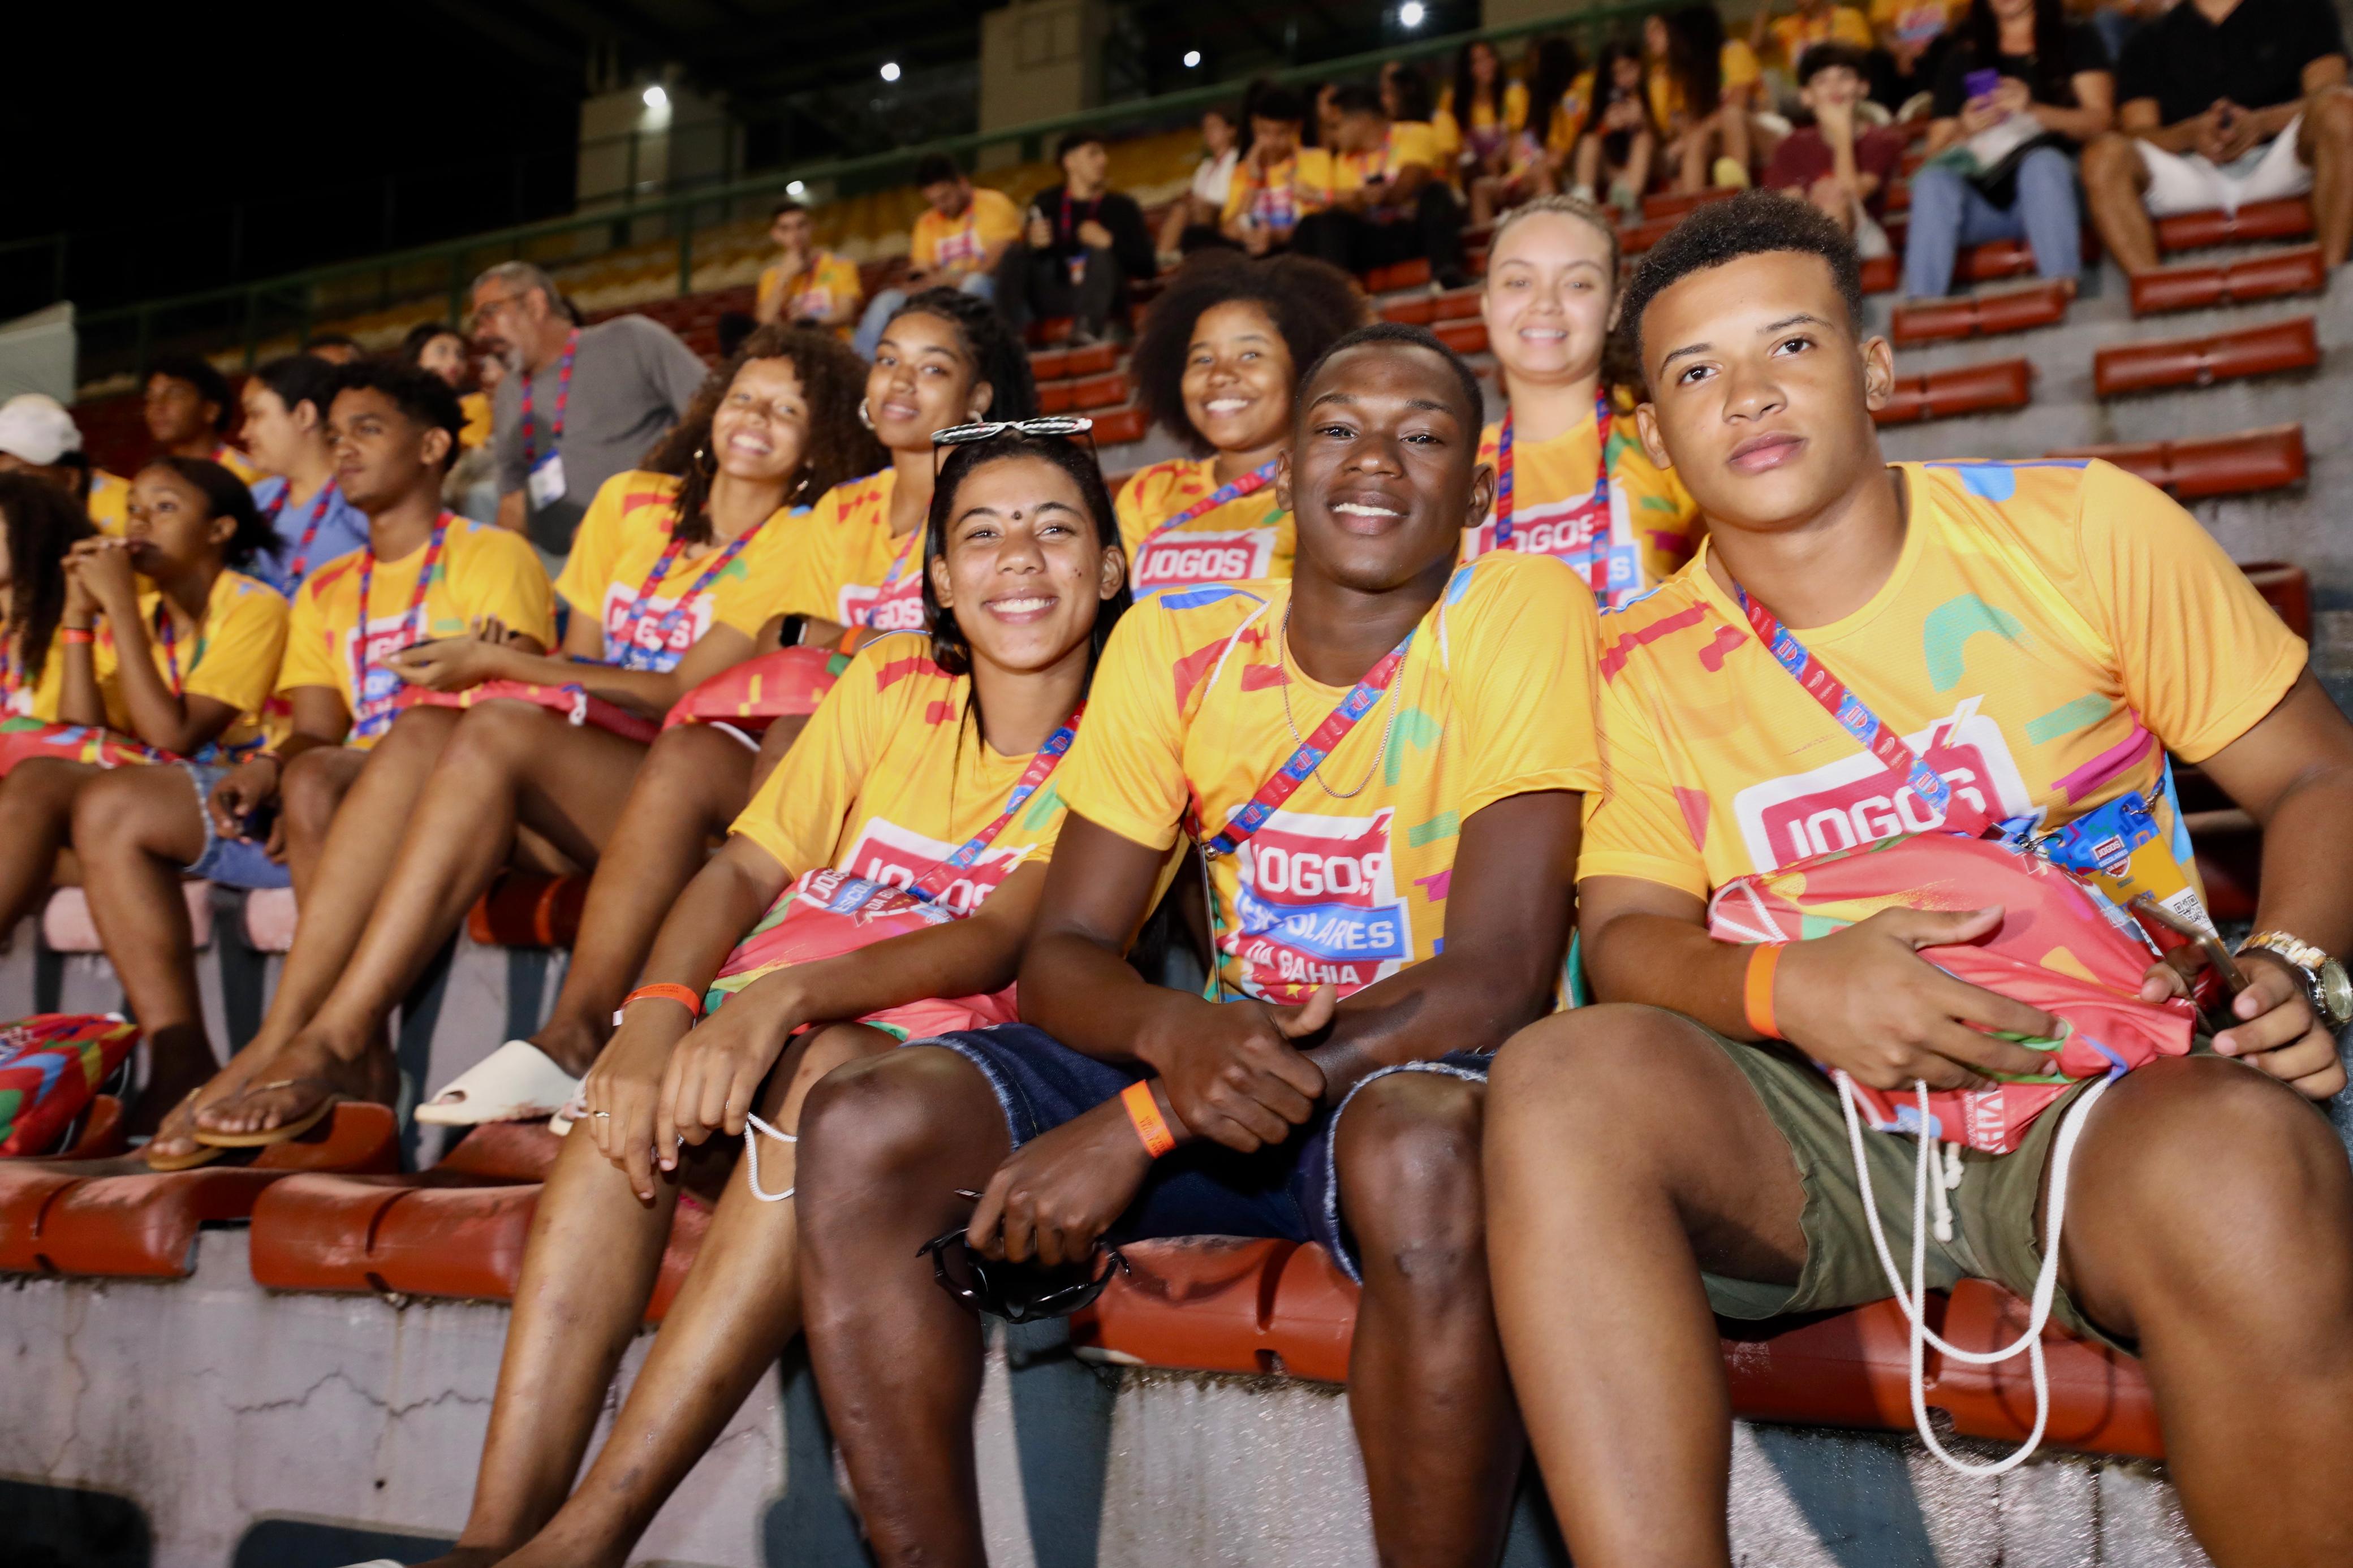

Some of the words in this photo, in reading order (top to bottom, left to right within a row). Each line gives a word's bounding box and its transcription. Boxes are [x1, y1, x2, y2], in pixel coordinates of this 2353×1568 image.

[1492, 513, 1596, 555] OGOS
[1142, 548, 1249, 580] JOGOS
[2098, 840, 2122, 858] JOGOS
[1278, 951, 1363, 984] BAHIA
